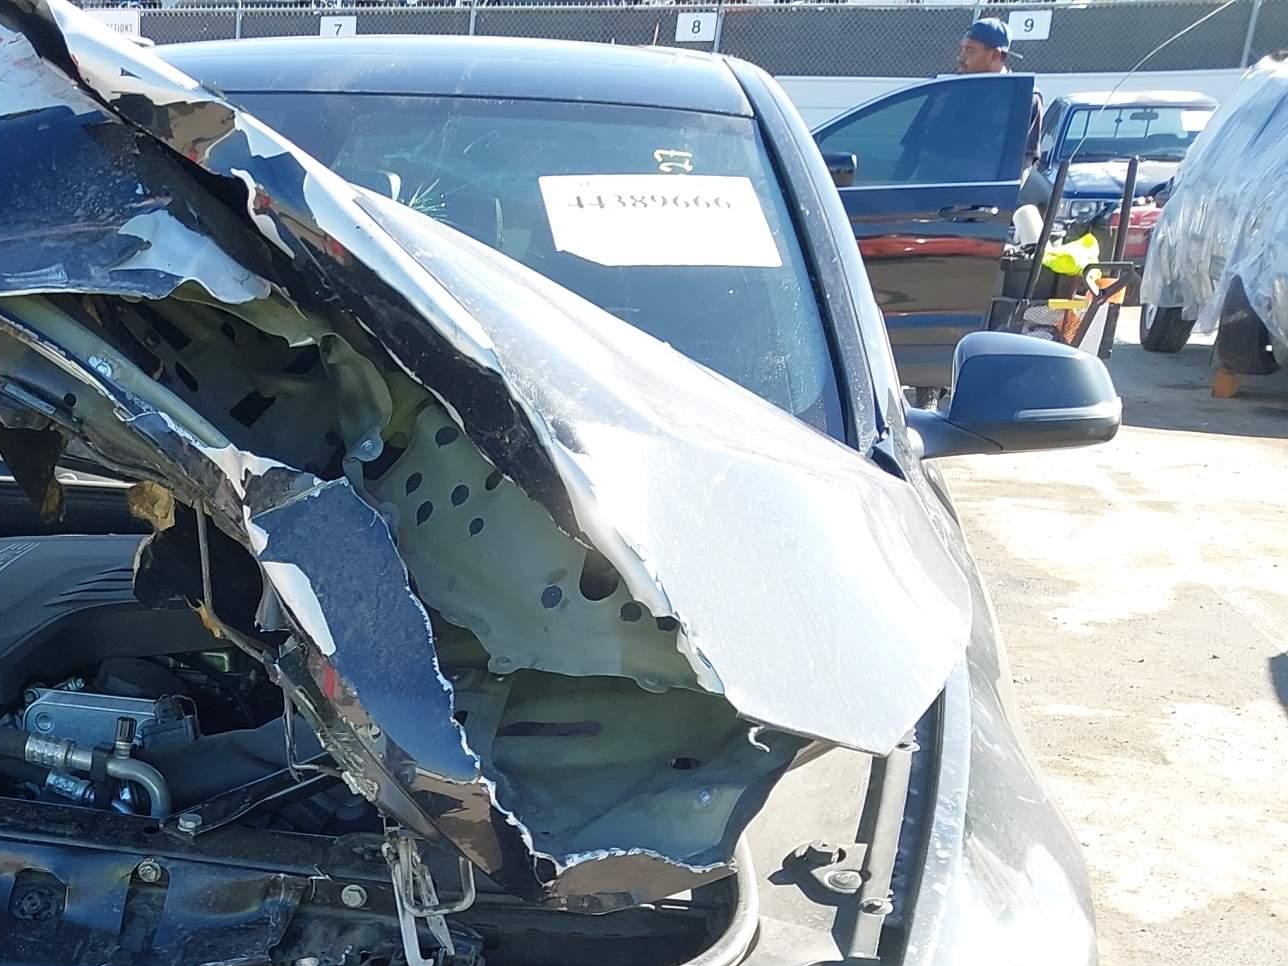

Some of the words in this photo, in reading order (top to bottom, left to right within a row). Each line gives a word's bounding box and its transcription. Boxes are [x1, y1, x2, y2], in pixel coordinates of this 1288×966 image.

[334, 24, 342, 36] 7
[691, 20, 702, 34] 8
[1024, 18, 1035, 32] 9
